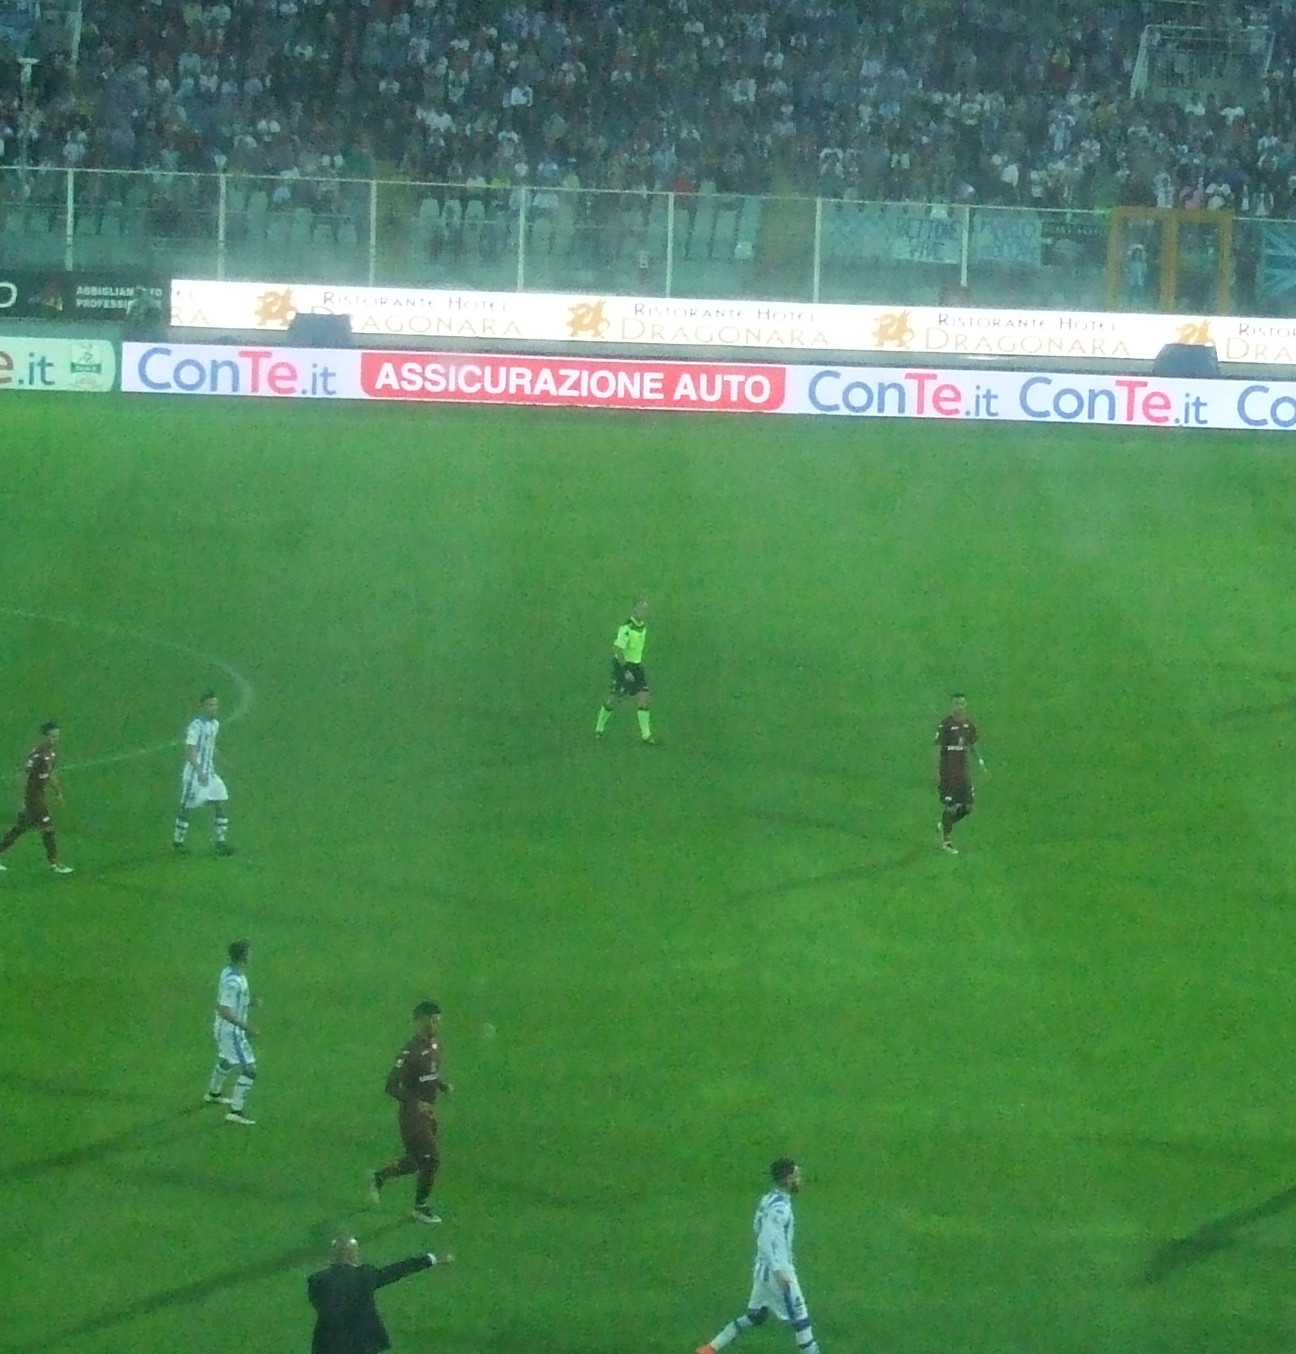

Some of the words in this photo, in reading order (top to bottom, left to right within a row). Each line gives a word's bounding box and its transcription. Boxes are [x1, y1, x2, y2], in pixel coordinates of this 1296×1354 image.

[76, 285, 163, 299] ABBIGLIAMTO
[621, 317, 829, 346] DRAGONARA
[925, 327, 1131, 356] DRAGONARA
[138, 347, 337, 396] ConTe.it
[374, 362, 665, 400] ASSICURAZIONE
[673, 374, 772, 403] AUTO
[808, 369, 999, 418] ConTe.it
[1019, 376, 1209, 425] ConTe.it
